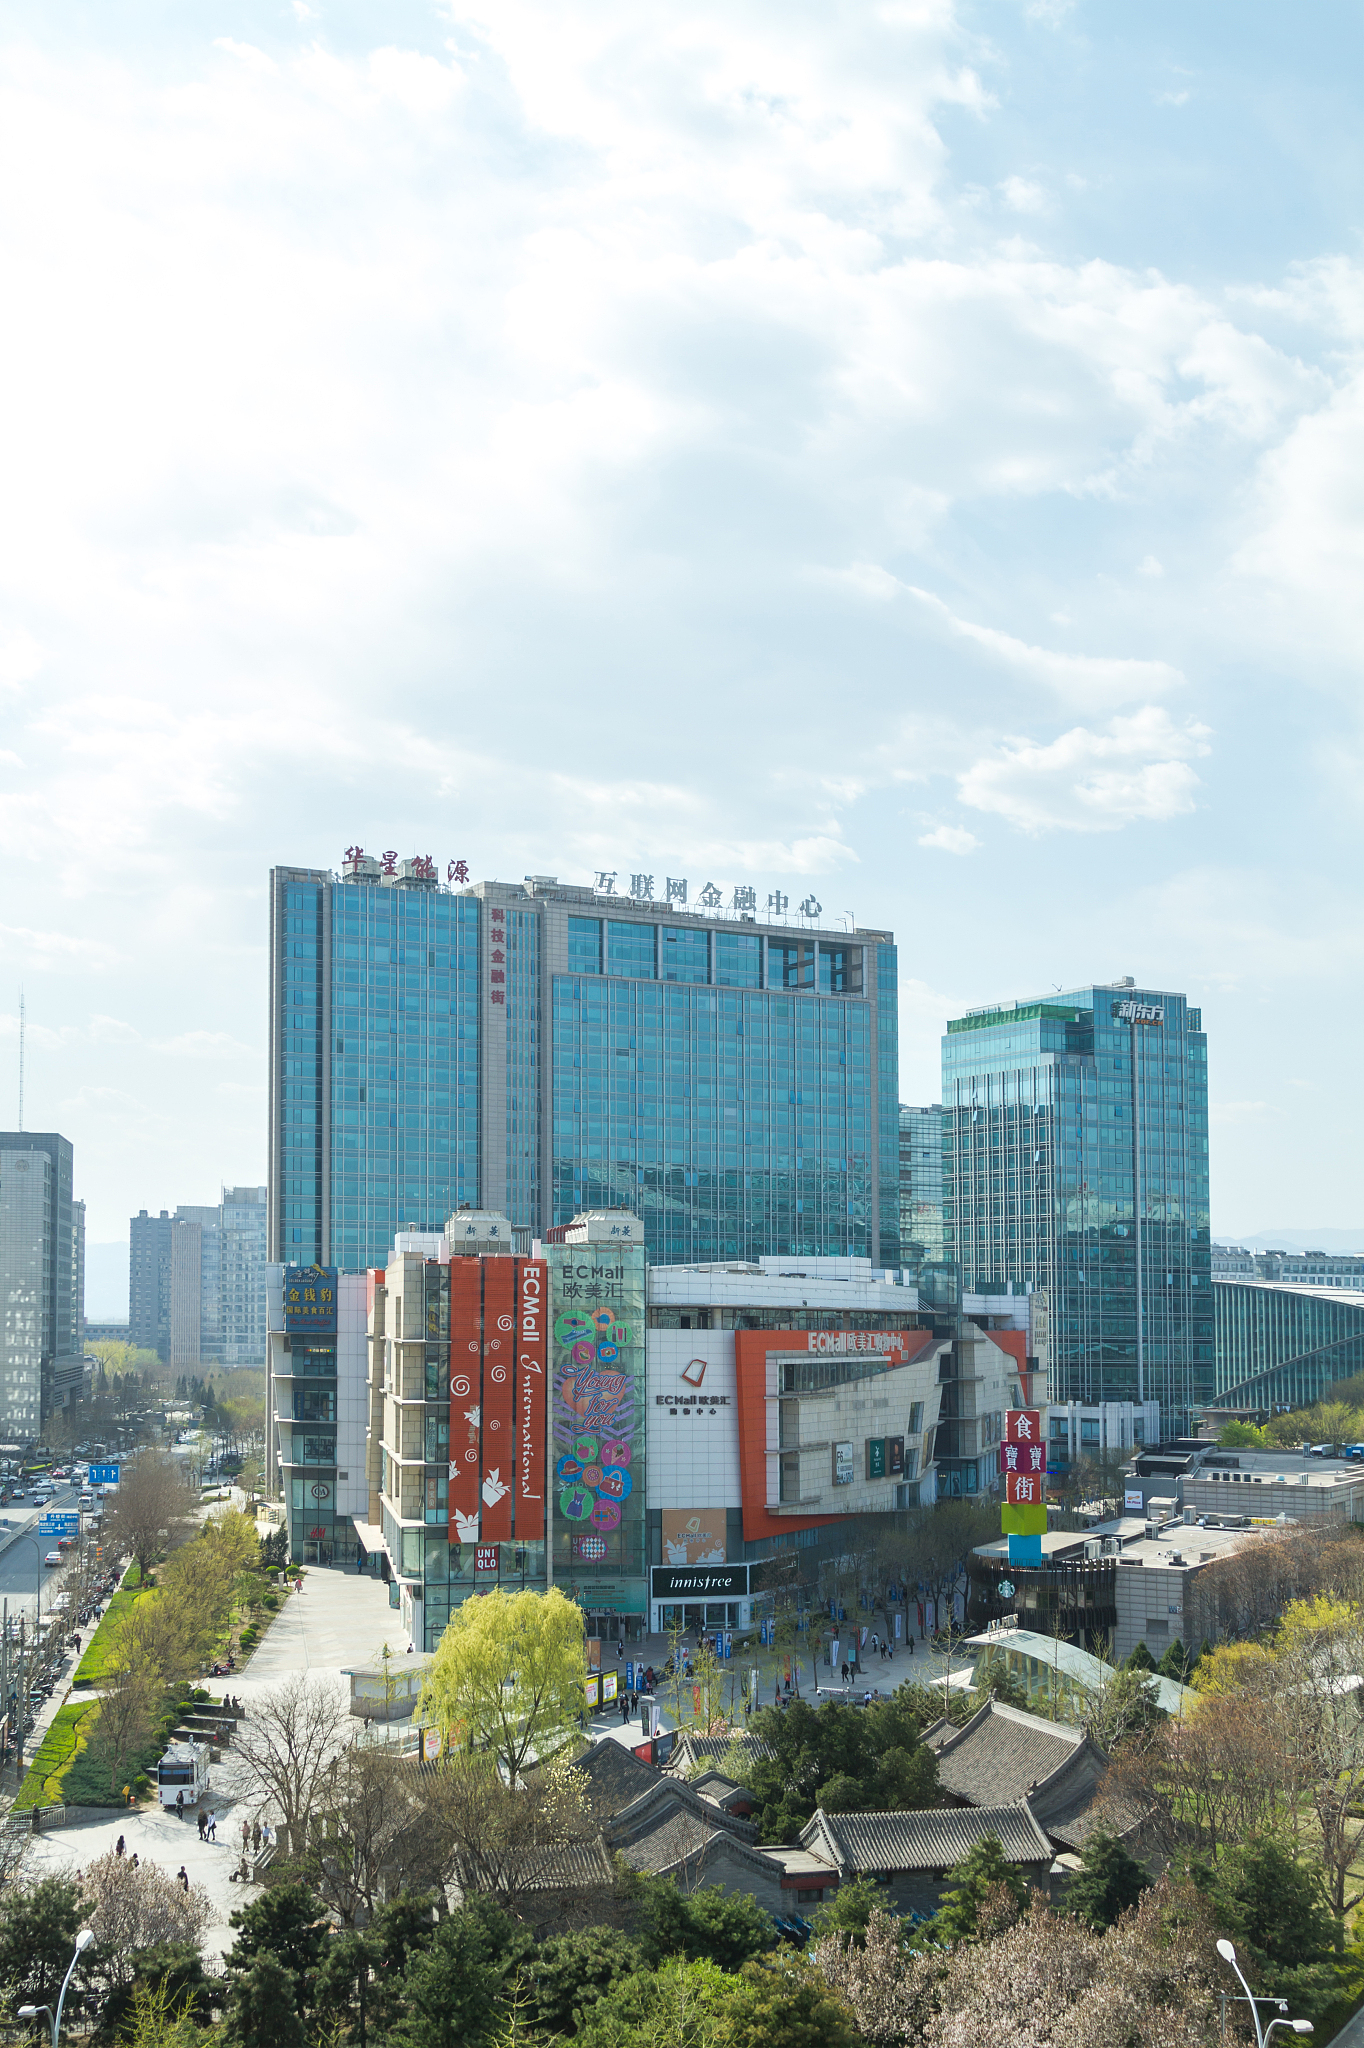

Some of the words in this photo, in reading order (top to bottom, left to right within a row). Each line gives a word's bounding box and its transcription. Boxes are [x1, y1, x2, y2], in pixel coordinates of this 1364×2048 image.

[342, 846, 470, 884] 华星能源
[594, 871, 823, 917] 互联网金融中心
[490, 908, 505, 1005] 科技金融街
[1118, 1000, 1165, 1023] 新东方
[562, 1265, 624, 1279] ECMall
[288, 1288, 332, 1302] 金钱豹
[562, 1282, 624, 1299] 欧美汇
[286, 1305, 334, 1315] 国际美食百汇
[522, 1267, 541, 1341] ECMall
[560, 1363, 626, 1402] Young
[584, 1393, 619, 1415] for
[520, 1354, 542, 1499] International
[570, 1413, 617, 1435] you
[310, 1527, 326, 1539] H&M
[477, 1549, 495, 1558] UNI
[477, 1559, 496, 1569] QLO
[669, 1575, 732, 1590] innisfree
